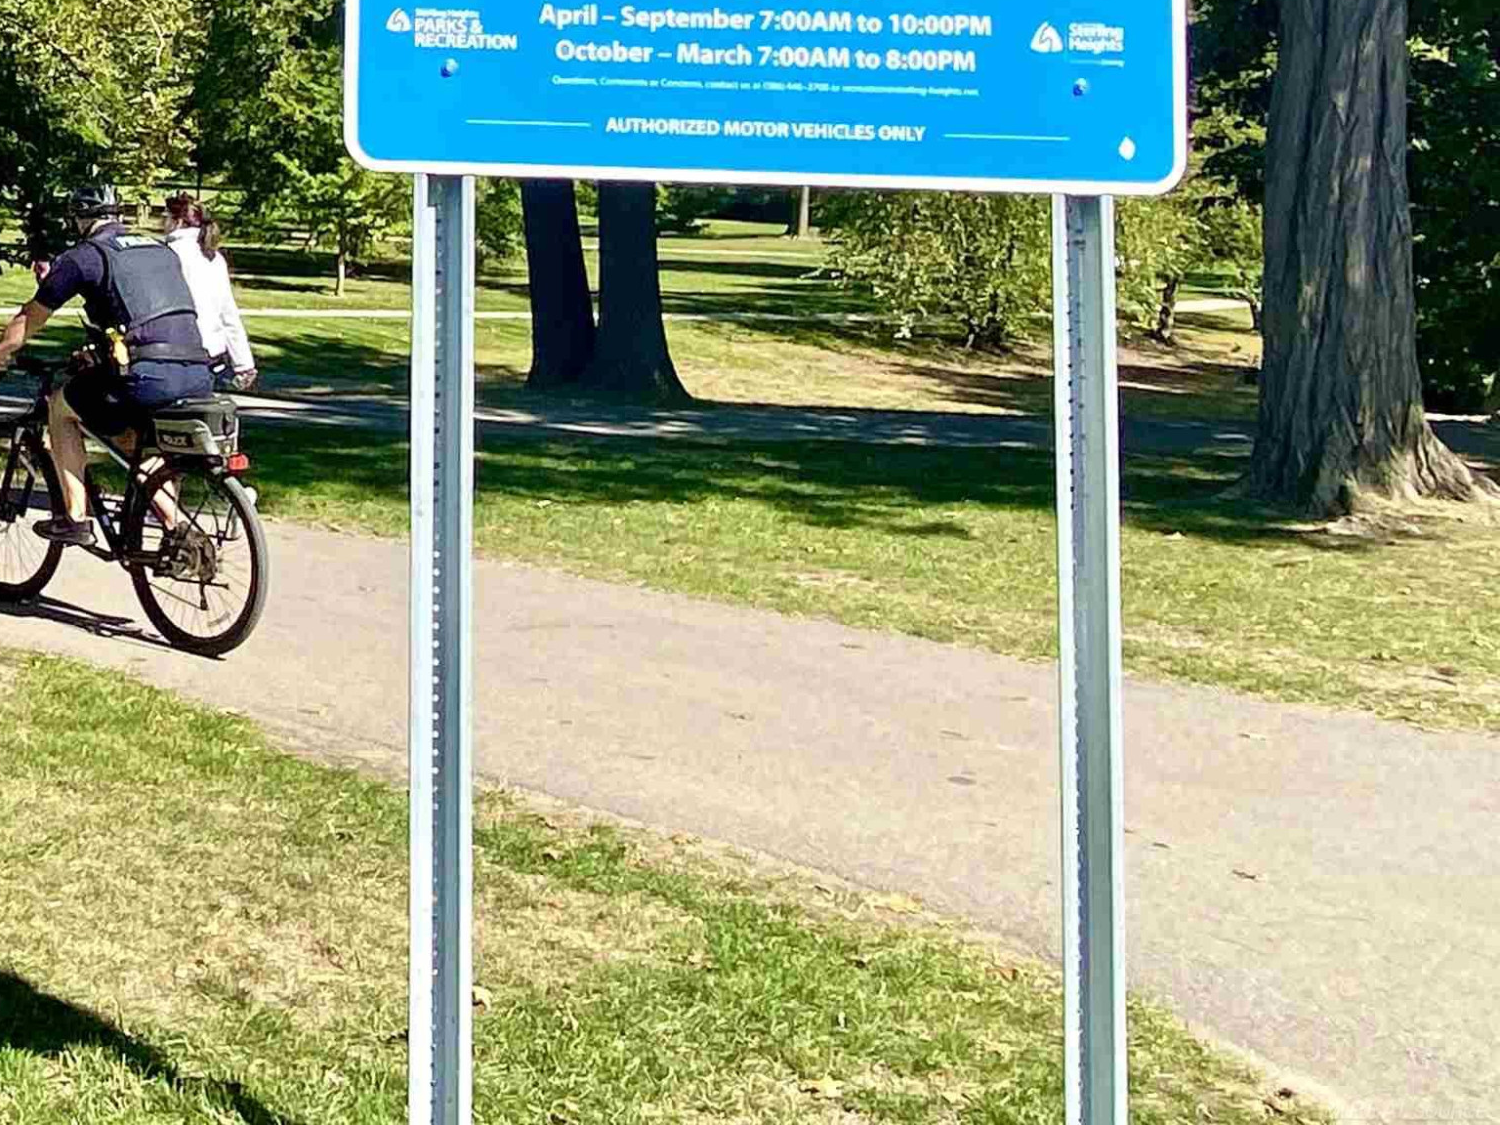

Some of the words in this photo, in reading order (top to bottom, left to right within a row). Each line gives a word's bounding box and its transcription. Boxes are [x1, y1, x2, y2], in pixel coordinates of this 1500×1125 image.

[415, 17, 468, 33] PARKS
[470, 19, 484, 33] &
[539, 4, 598, 30] April
[621, 5, 755, 32] September
[759, 10, 854, 32] 7:00AM
[855, 15, 883, 33] to
[889, 14, 992, 35] 10:00PM
[414, 33, 518, 50] RECREATION
[555, 39, 653, 62] October
[677, 43, 752, 65] March
[758, 46, 851, 68] 7:00AM
[854, 50, 883, 69] to
[883, 49, 976, 72] 8:00PM
[606, 117, 722, 135] AUTHORIZED
[722, 120, 791, 138] MOTOR
[791, 123, 876, 140] VEHICLES
[878, 125, 925, 141] ONLY
